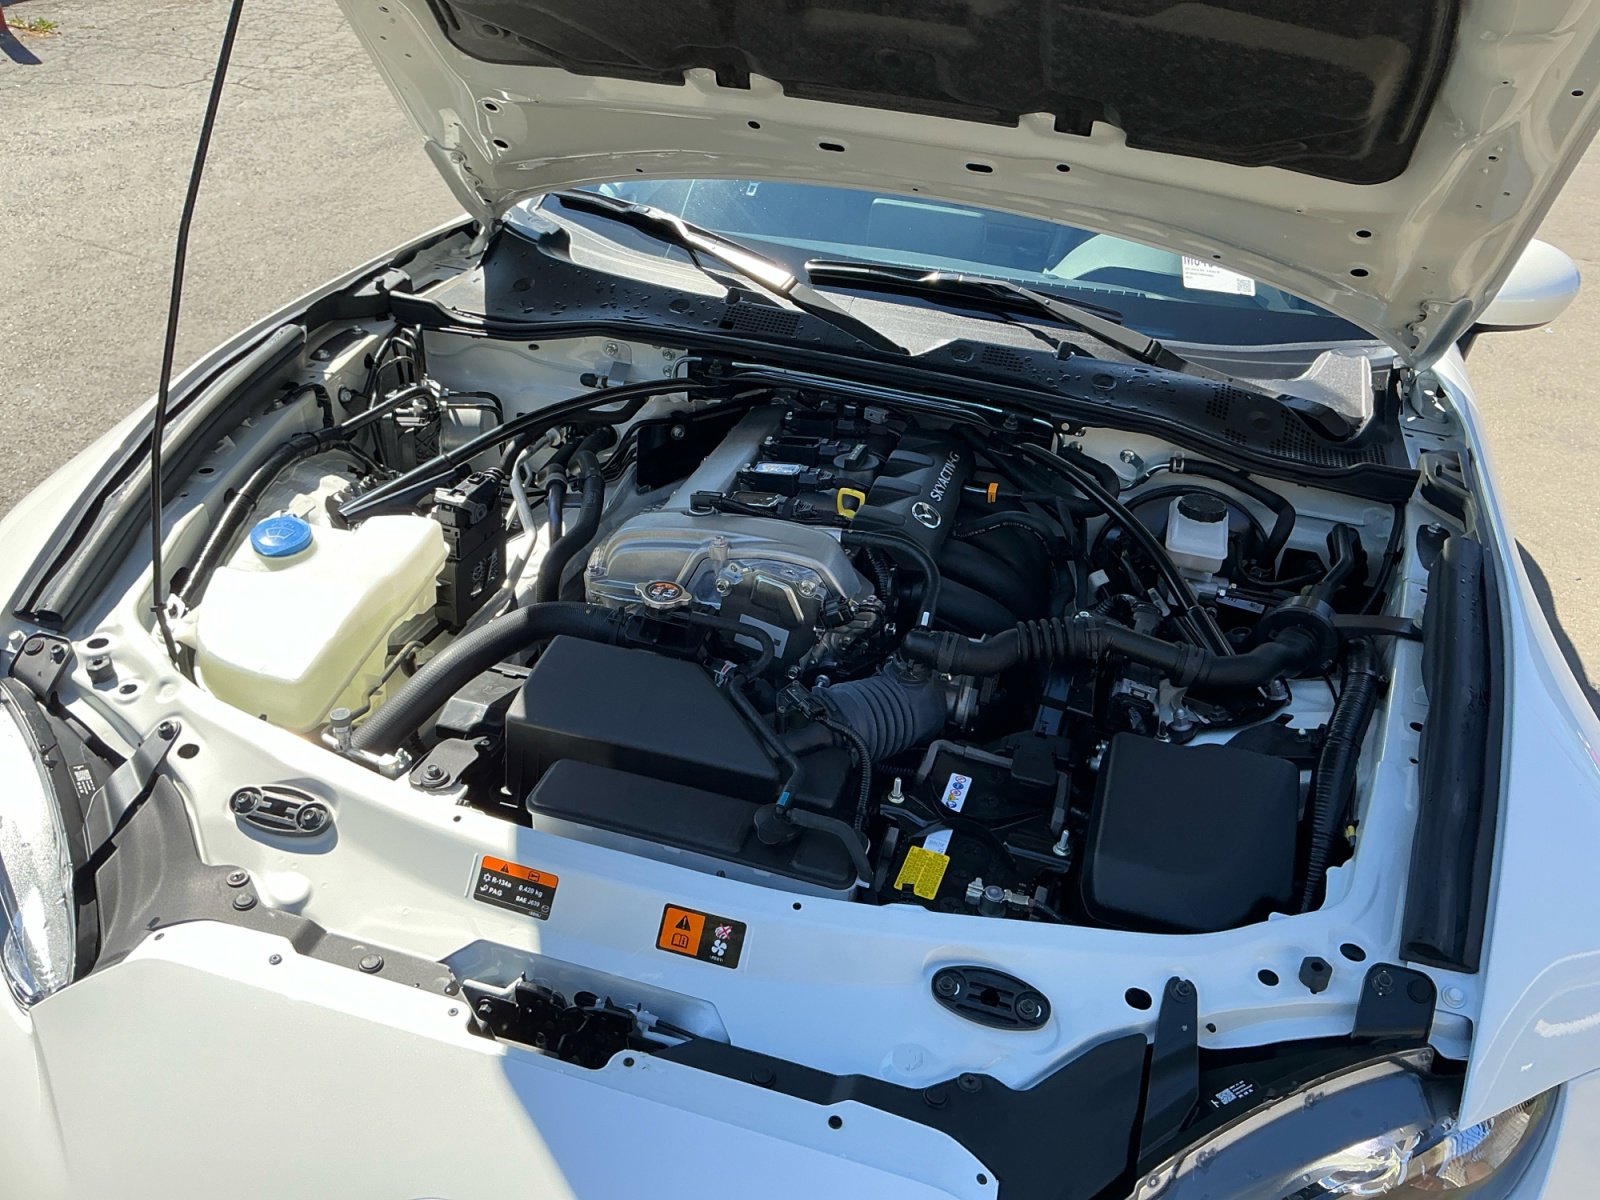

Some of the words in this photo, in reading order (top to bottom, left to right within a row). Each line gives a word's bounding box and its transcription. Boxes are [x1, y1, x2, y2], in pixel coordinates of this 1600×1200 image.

[929, 450, 961, 502] SKYACTIV-G
[488, 886, 503, 897] PAG
[491, 876, 512, 889] R-134a
[535, 890, 543, 898] kg
